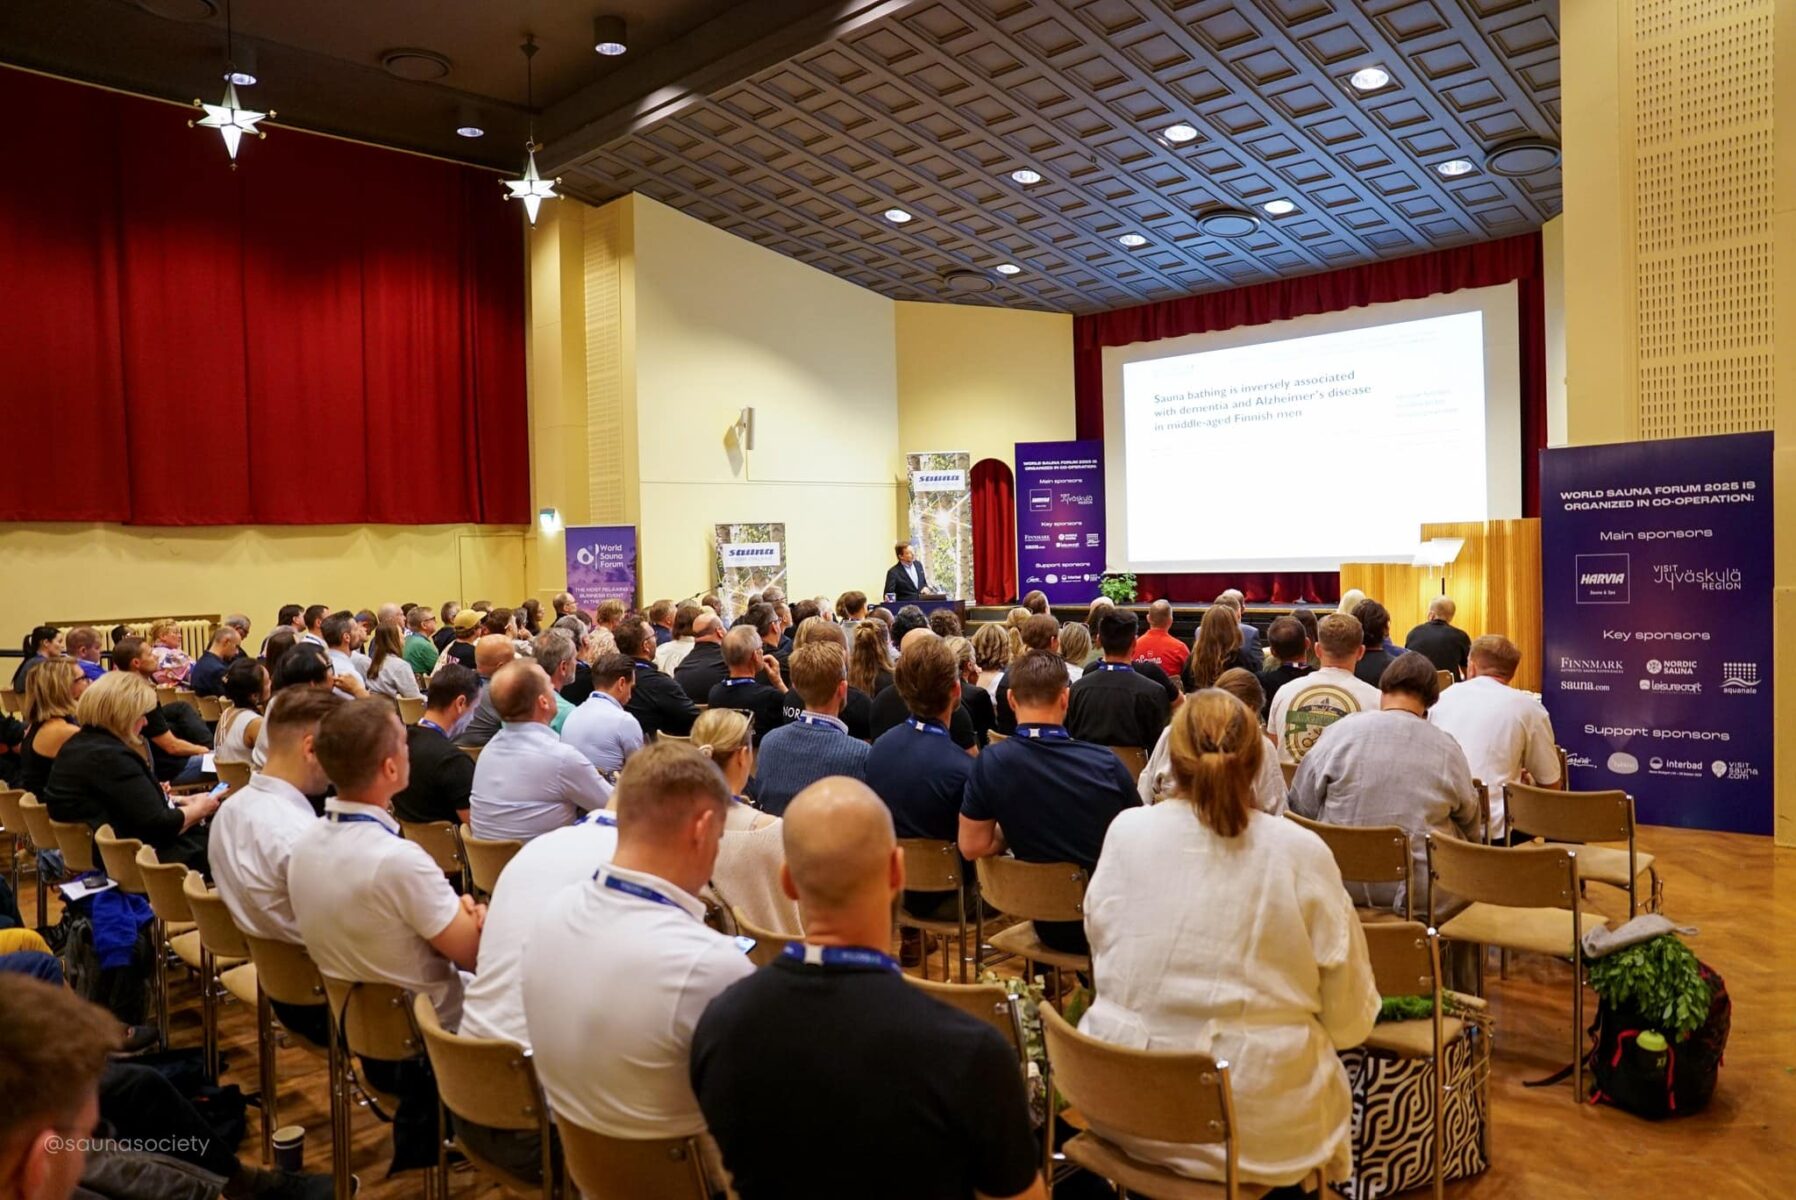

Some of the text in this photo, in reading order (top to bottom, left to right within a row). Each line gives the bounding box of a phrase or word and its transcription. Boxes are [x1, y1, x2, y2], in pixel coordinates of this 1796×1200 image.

[1154, 370, 1355, 404] Sauna bathing is inversely associated
[1154, 386, 1372, 418] with dementia and Alzheimer's disease
[1154, 408, 1302, 432] in middle-aged Finnish men
[1560, 480, 1756, 500] WORLD SAUNA FORUM 2025 IS
[1564, 494, 1755, 511] ORGANIZED IN CO-OPERATION:
[1600, 528, 1713, 541] Main sponsors
[1653, 564, 1678, 572] VISIT
[1580, 573, 1625, 584] HARVIA
[1654, 568, 1742, 591] Jyväskylä
[1702, 582, 1741, 590] REGION
[1603, 630, 1710, 642] Key sponsors
[1561, 657, 1623, 669] FINNMARK
[1560, 680, 1610, 691] sauna.com
[783, 706, 801, 720] NOR
[1584, 724, 1730, 741] Support sponsors
